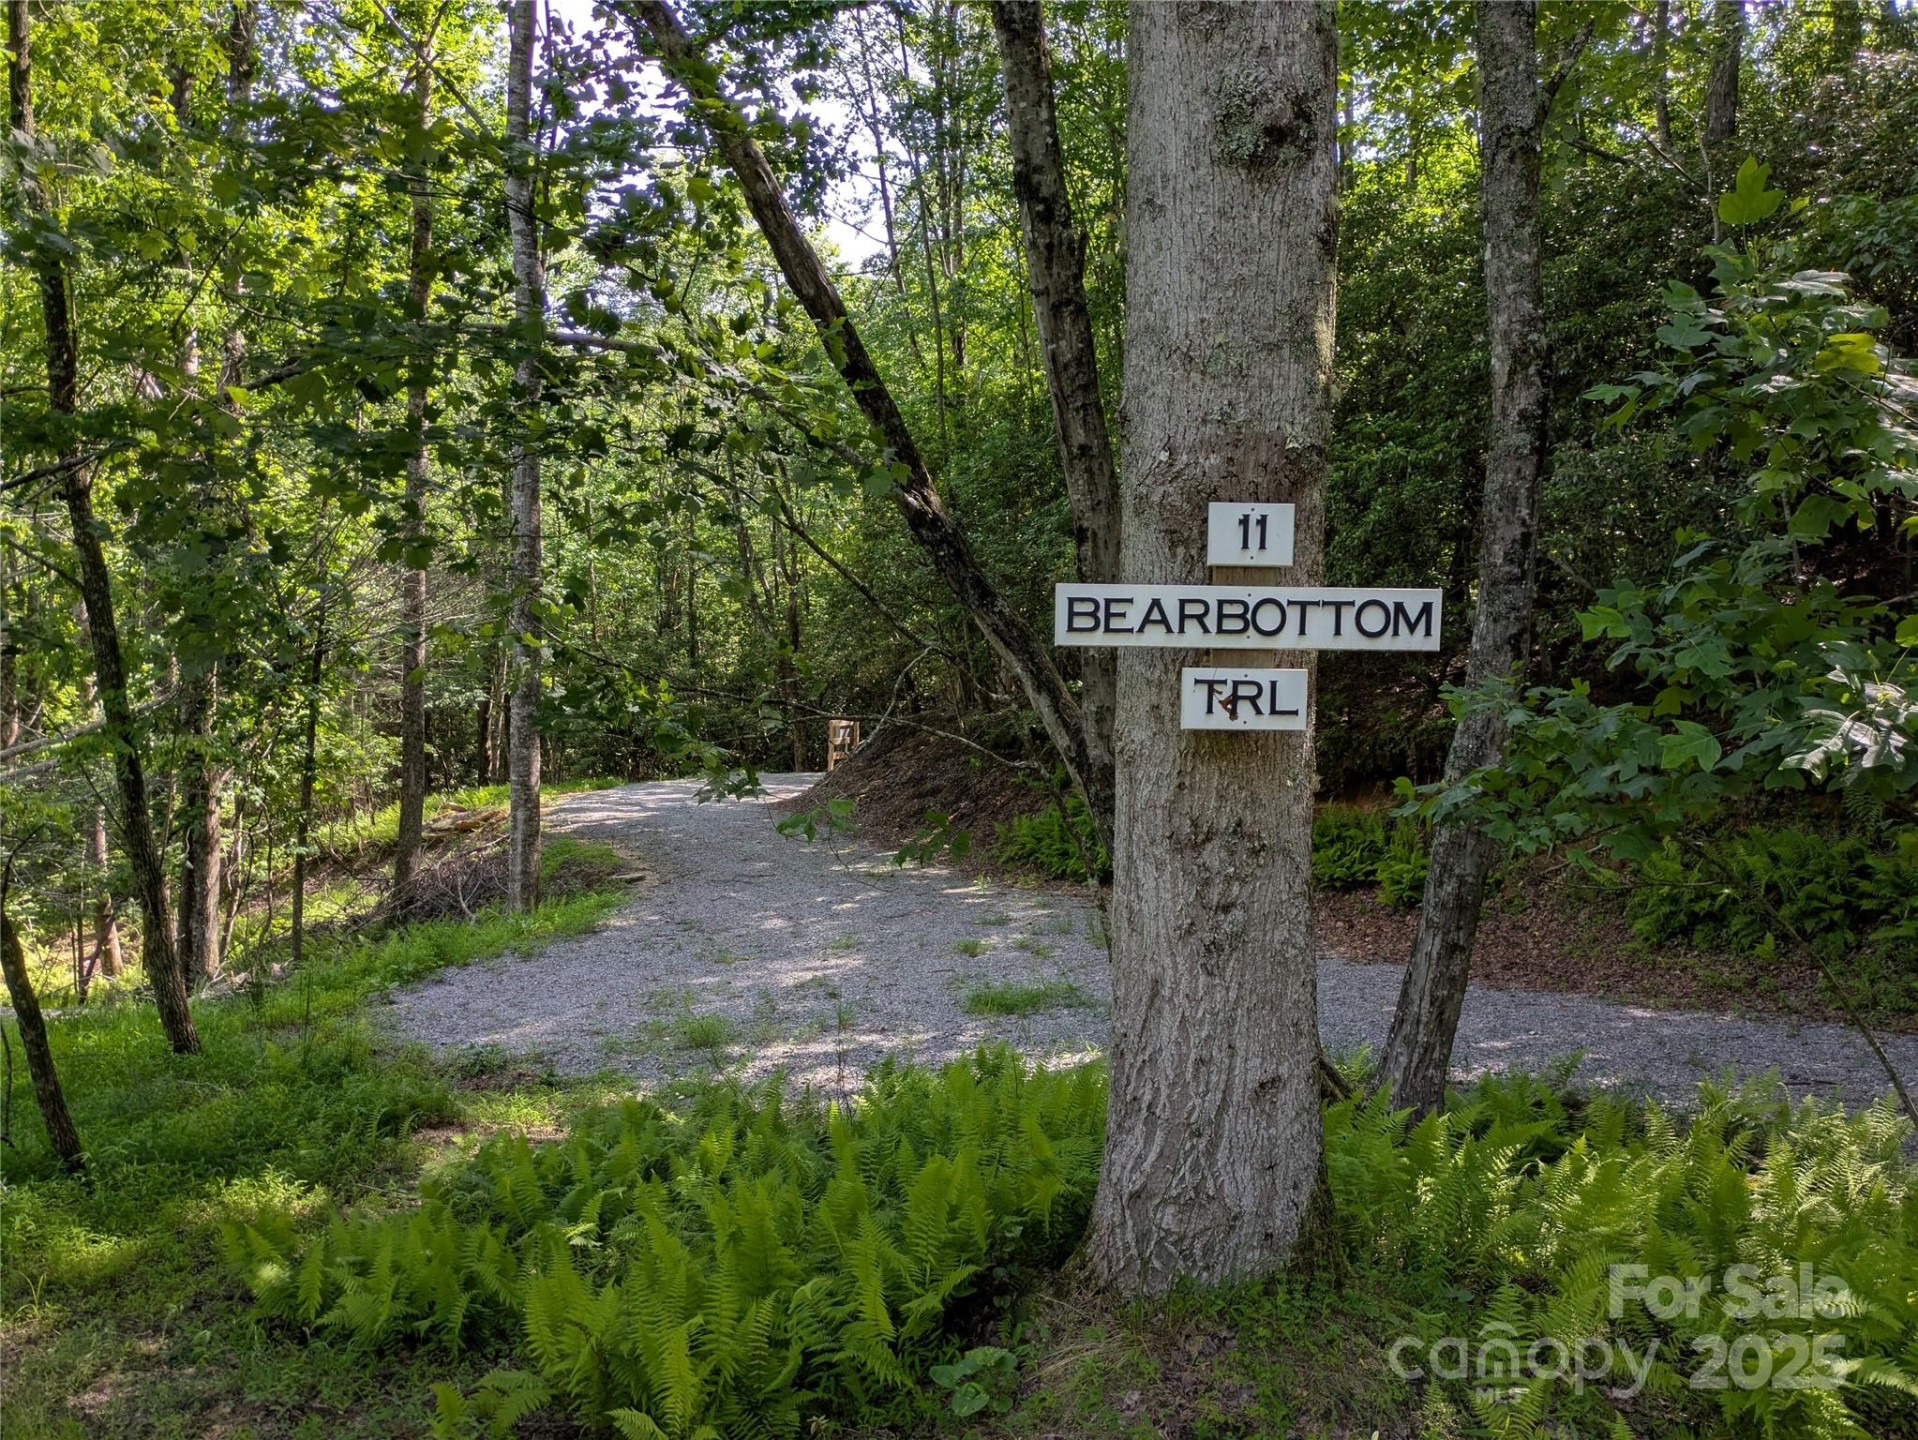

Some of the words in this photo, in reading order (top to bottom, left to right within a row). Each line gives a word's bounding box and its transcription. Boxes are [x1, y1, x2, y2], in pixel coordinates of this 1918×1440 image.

[1238, 513, 1269, 550] 11
[1066, 596, 1434, 638] BEARBOTTOM
[1194, 678, 1299, 717] TRL
